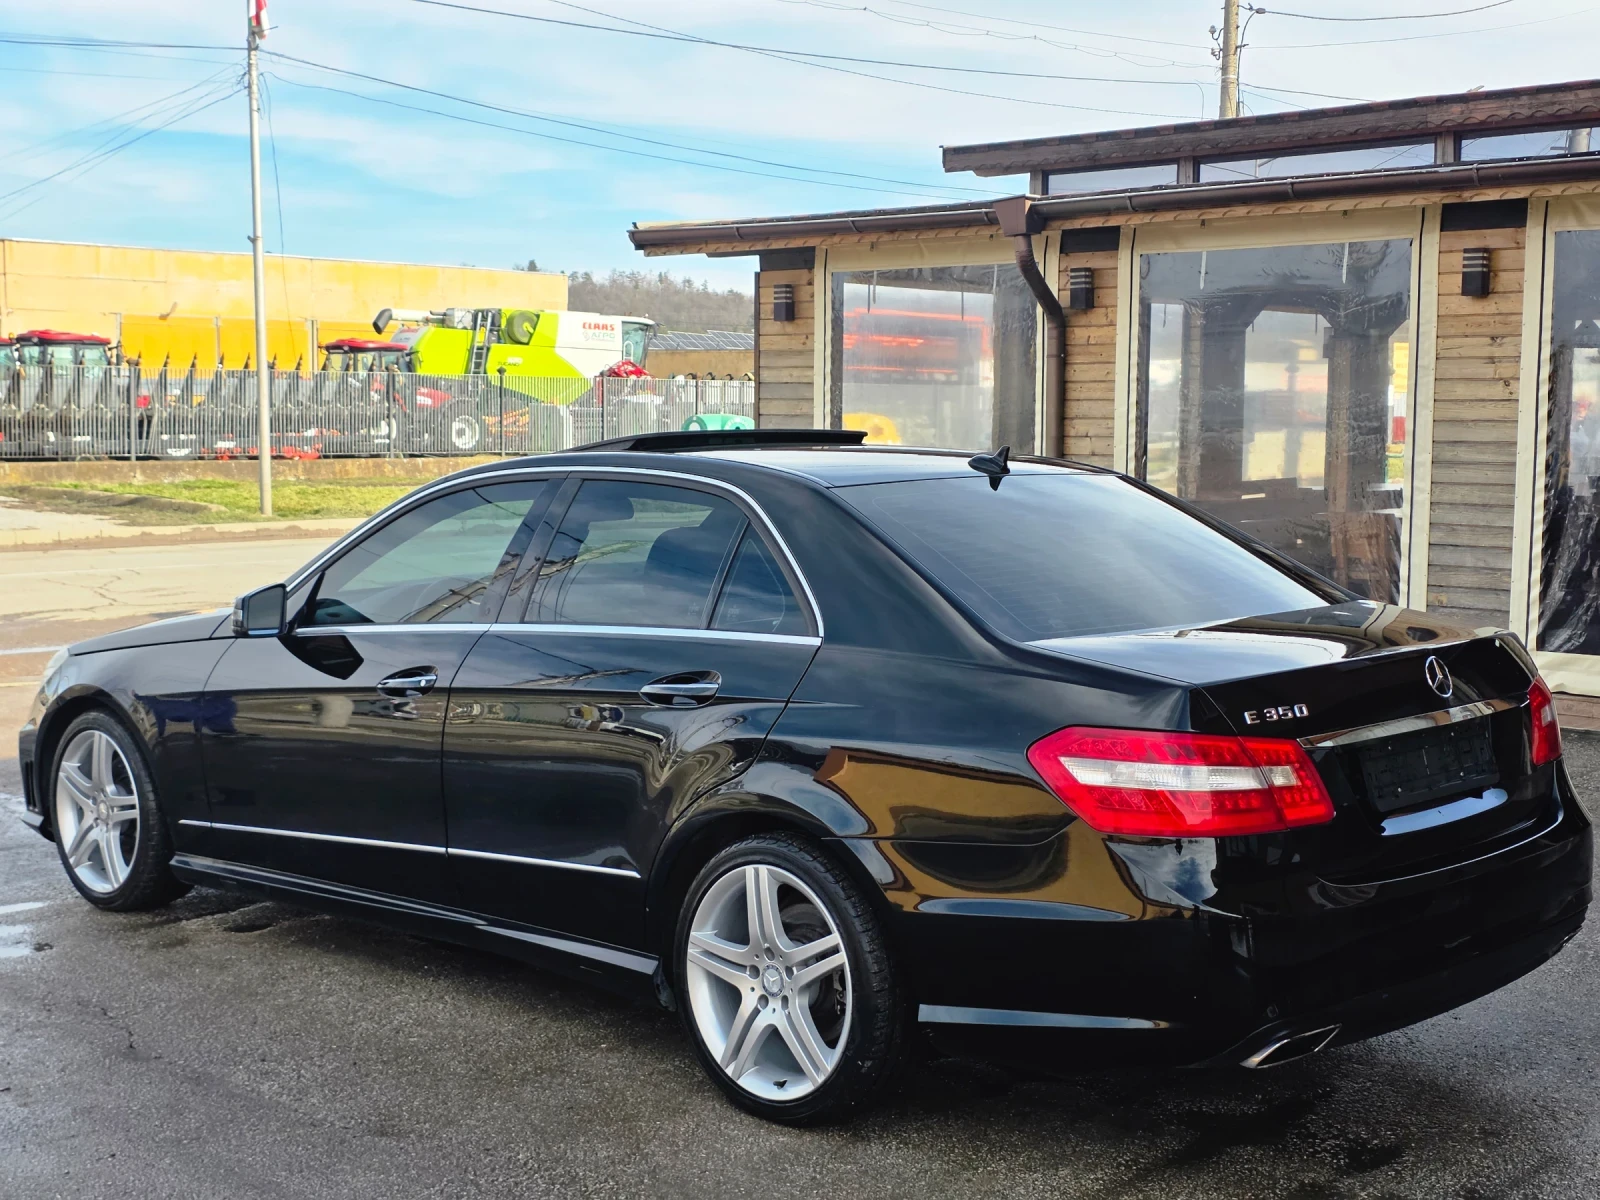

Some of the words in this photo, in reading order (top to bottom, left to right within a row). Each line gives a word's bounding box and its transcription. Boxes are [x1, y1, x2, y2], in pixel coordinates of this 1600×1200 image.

[582, 322, 615, 331] CLAAS
[1244, 710, 1260, 724] E
[1263, 704, 1309, 721] 350
